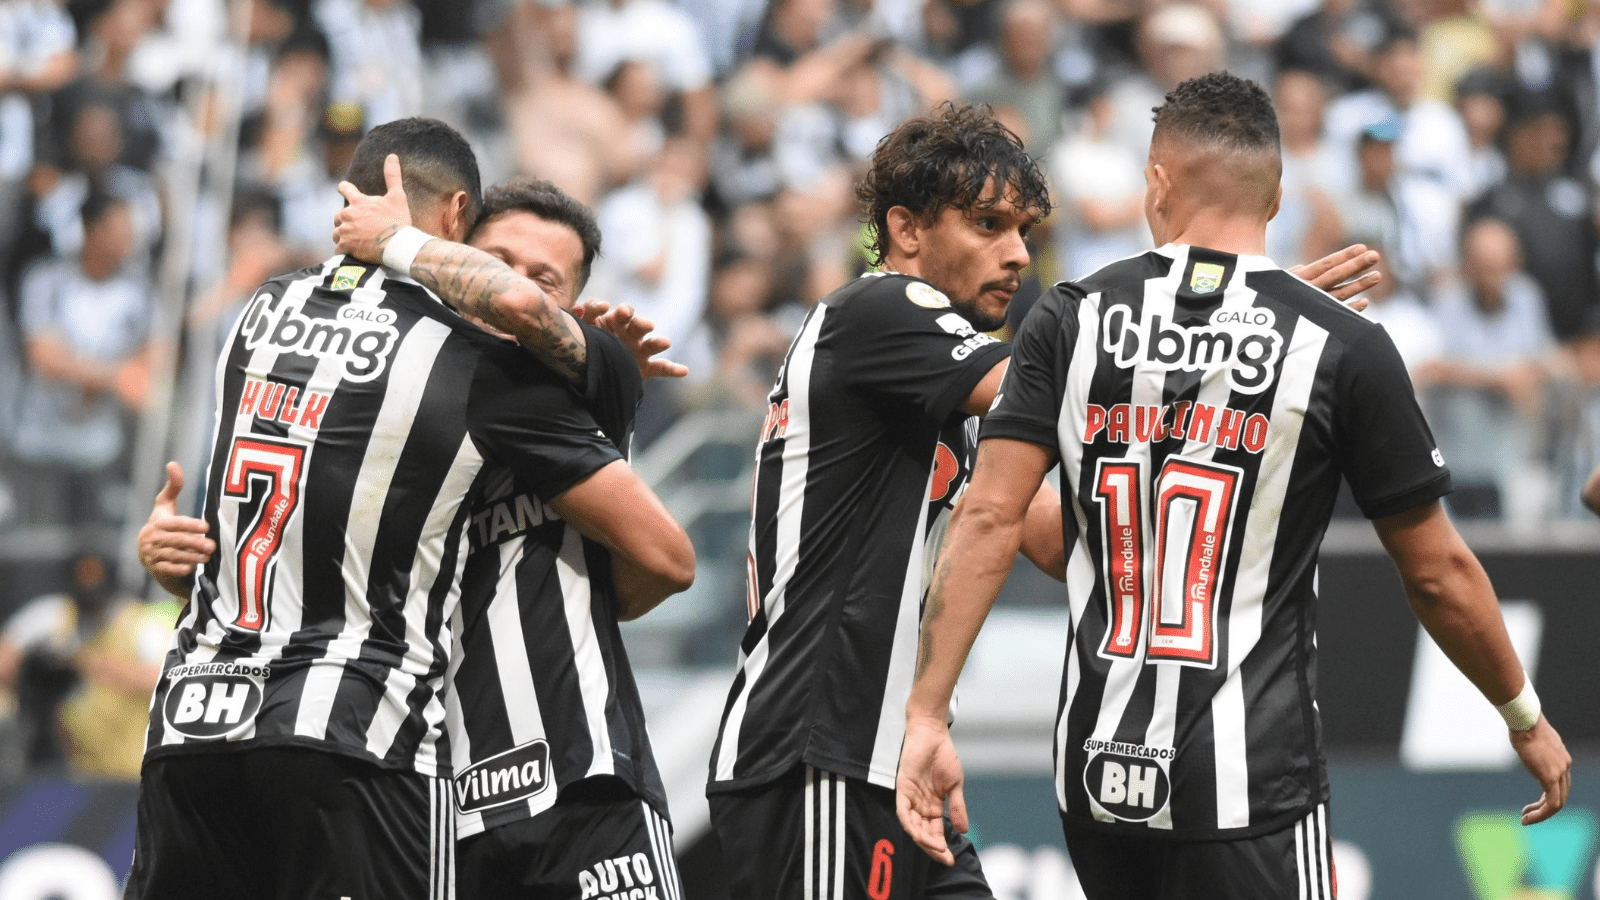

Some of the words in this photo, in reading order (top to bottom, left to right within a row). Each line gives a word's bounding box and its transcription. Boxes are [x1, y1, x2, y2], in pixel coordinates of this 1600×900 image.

[269, 305, 391, 374] bmg
[342, 307, 390, 324] GALO
[1216, 310, 1269, 326] GALO
[1147, 314, 1276, 388] bmg
[238, 379, 329, 430] HULK
[1083, 400, 1270, 454] PAULINHO
[223, 437, 305, 630] 7
[252, 498, 289, 556] mundiale
[1095, 457, 1241, 666] 10
[1119, 527, 1134, 592] mundiale
[1191, 534, 1216, 600] mundiale
[167, 662, 271, 679] SUPERMERCADOS
[174, 682, 250, 724] BH
[1083, 738, 1176, 760] SUPERMERCADOS
[1100, 761, 1158, 808] BH
[579, 852, 653, 900] AUTO
[868, 839, 895, 900] 6
